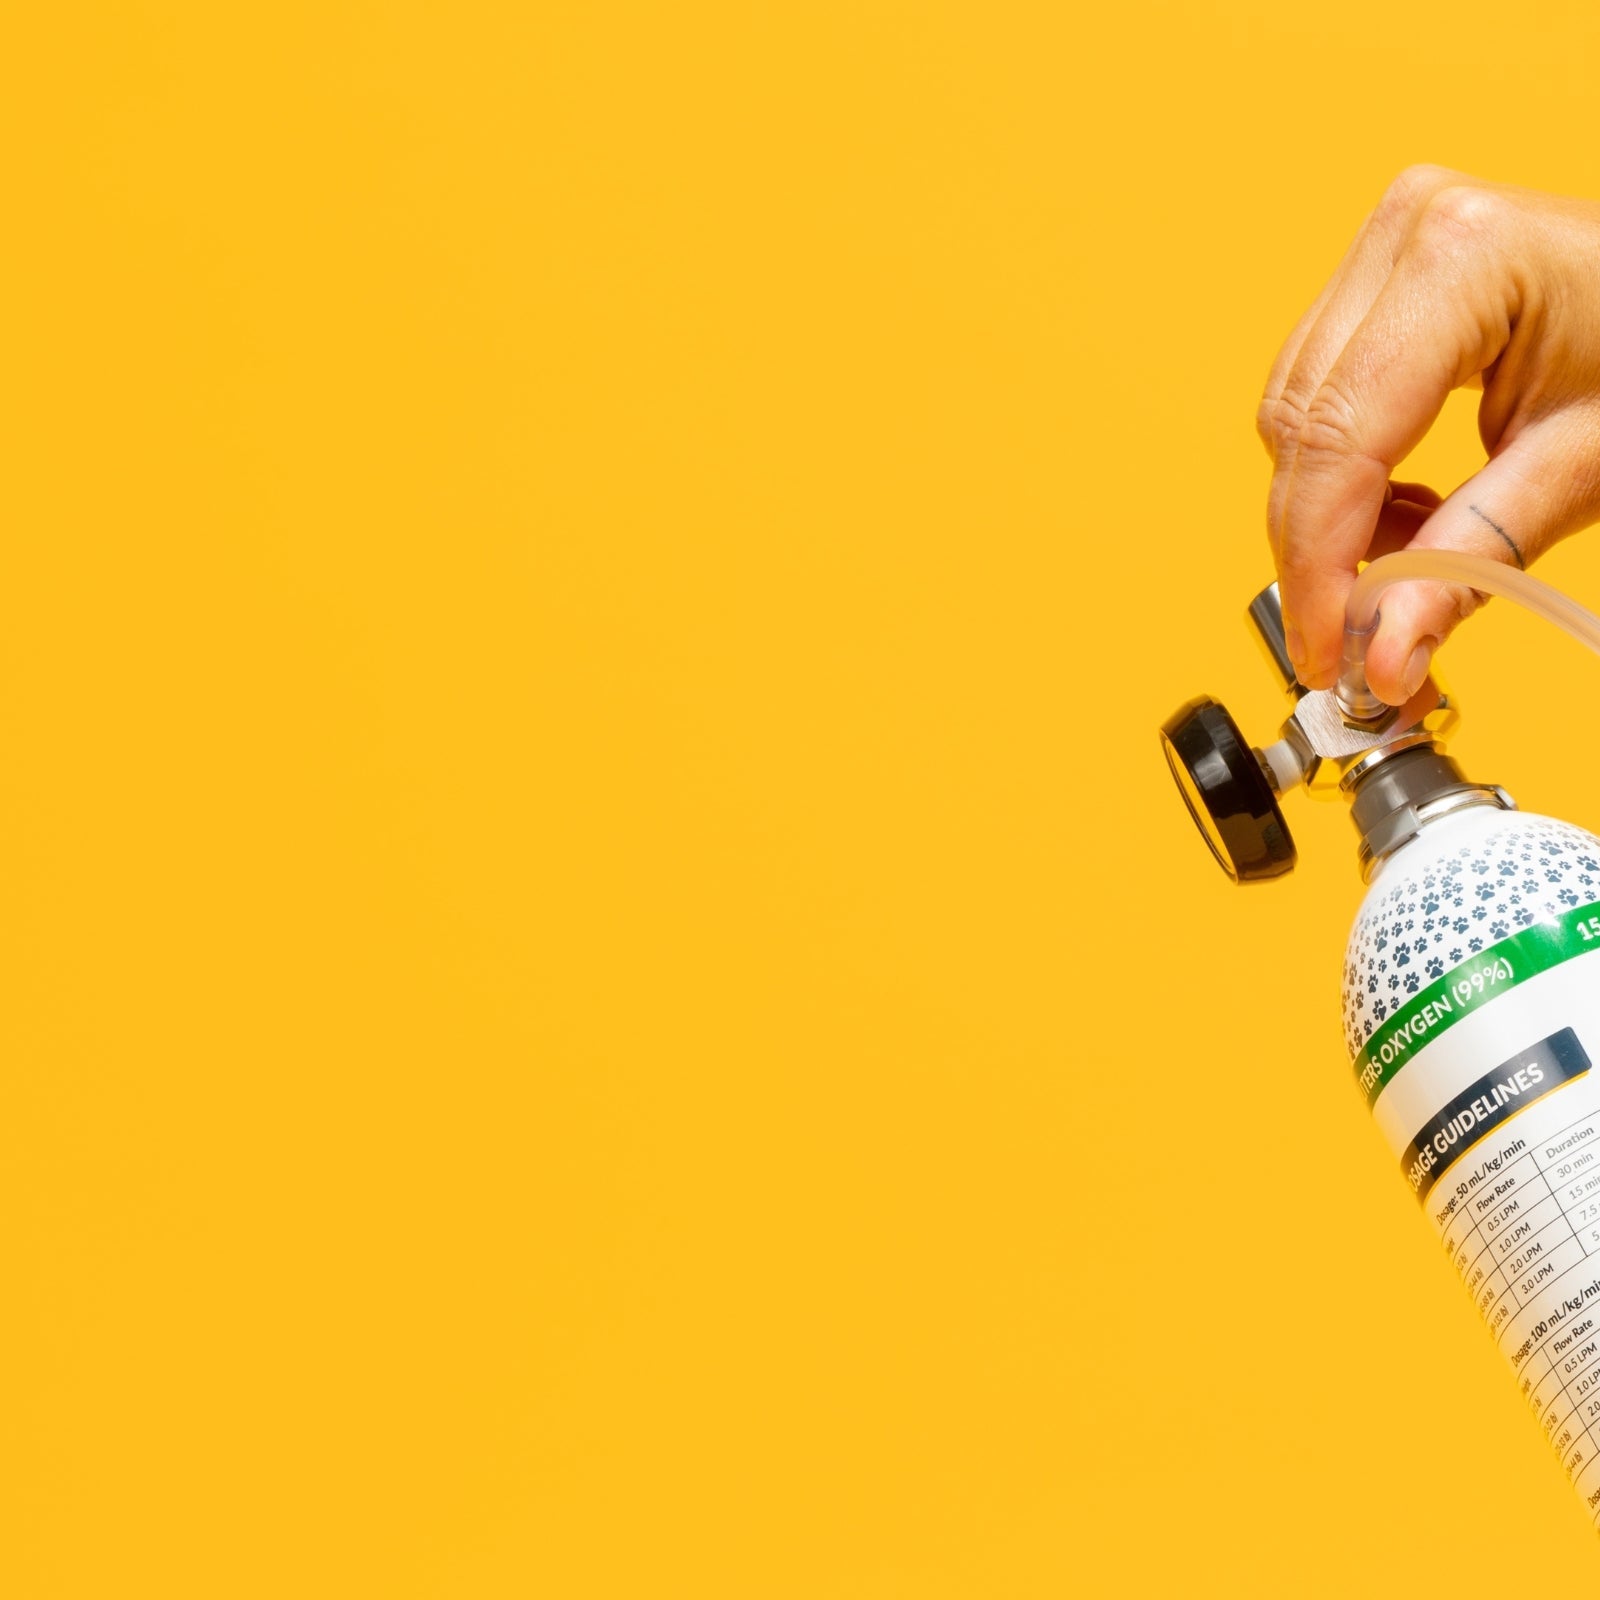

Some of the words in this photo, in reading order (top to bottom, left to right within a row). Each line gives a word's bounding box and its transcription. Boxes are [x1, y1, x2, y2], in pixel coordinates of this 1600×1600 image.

[1380, 994, 1453, 1064] OXYGEN
[1453, 957, 1514, 1007] (99%)
[1408, 1144, 1438, 1192] OSAGE
[1434, 1063, 1544, 1154] GUIDELINES
[1546, 1126, 1595, 1159] Duration
[1456, 1183, 1470, 1199] 50
[1468, 1137, 1527, 1188] mL/kg/min
[1557, 1164, 1572, 1178] 30
[1573, 1152, 1594, 1170] min
[1476, 1193, 1496, 1213] Flow
[1494, 1177, 1516, 1198] Rate
[1569, 1185, 1582, 1200] 15
[1487, 1213, 1503, 1232] 0.5
[1500, 1201, 1520, 1222] LPM
[1579, 1205, 1596, 1221] 7.5
[1498, 1235, 1514, 1254] 1.0
[1510, 1222, 1531, 1243] LPM
[1591, 1230, 1600, 1242] 5
[1510, 1255, 1526, 1275] 2.0
[1522, 1243, 1543, 1265] LPM
[1521, 1276, 1538, 1295] 3.0
[1532, 1263, 1554, 1285] LPM
[1531, 1321, 1548, 1345] 100
[1553, 1335, 1573, 1354] Flow
[1570, 1319, 1594, 1340] Rate
[1564, 1356, 1578, 1374] 0.5
[1577, 1342, 1598, 1365] LPM
[1576, 1377, 1590, 1395] 1.0
[1587, 1398, 1600, 1417] 2.0
